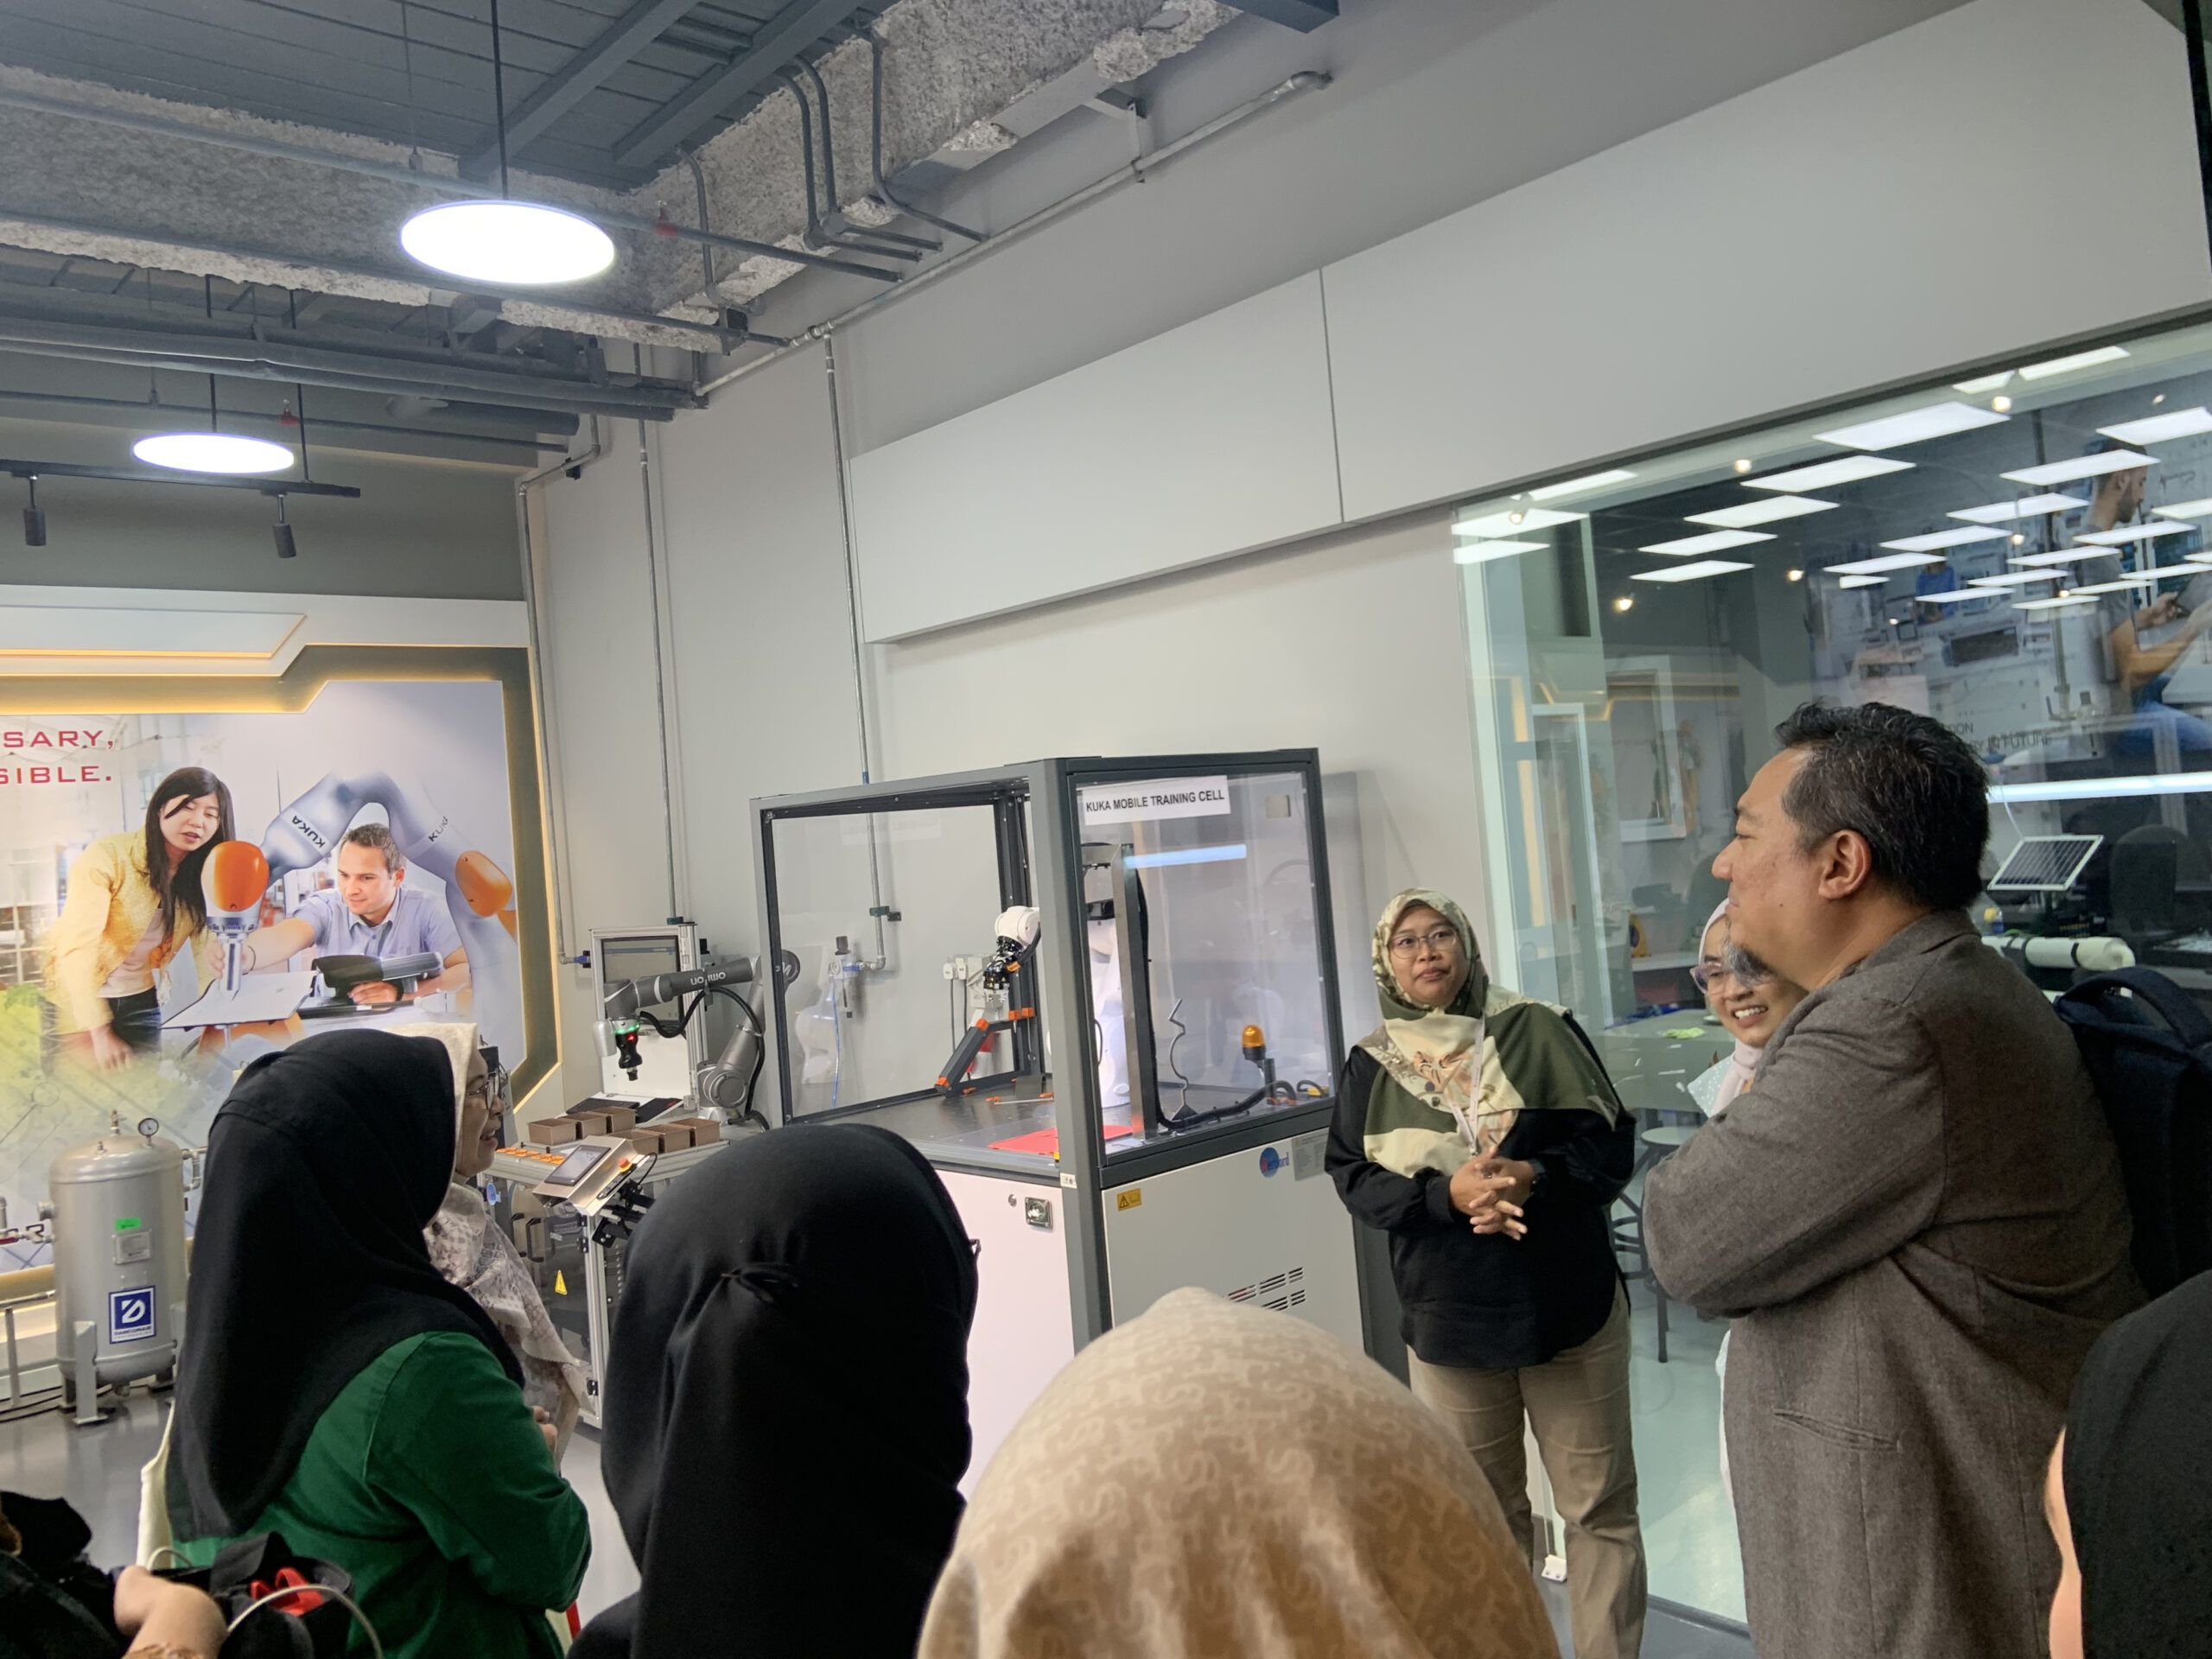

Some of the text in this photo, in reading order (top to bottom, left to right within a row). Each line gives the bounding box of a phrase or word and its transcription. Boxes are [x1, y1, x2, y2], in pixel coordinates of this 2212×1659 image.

[3, 730, 113, 749] SARY,
[1086, 789, 1224, 812] KUKA MOBILE TRAINING CELL
[292, 815, 326, 848] KUKA
